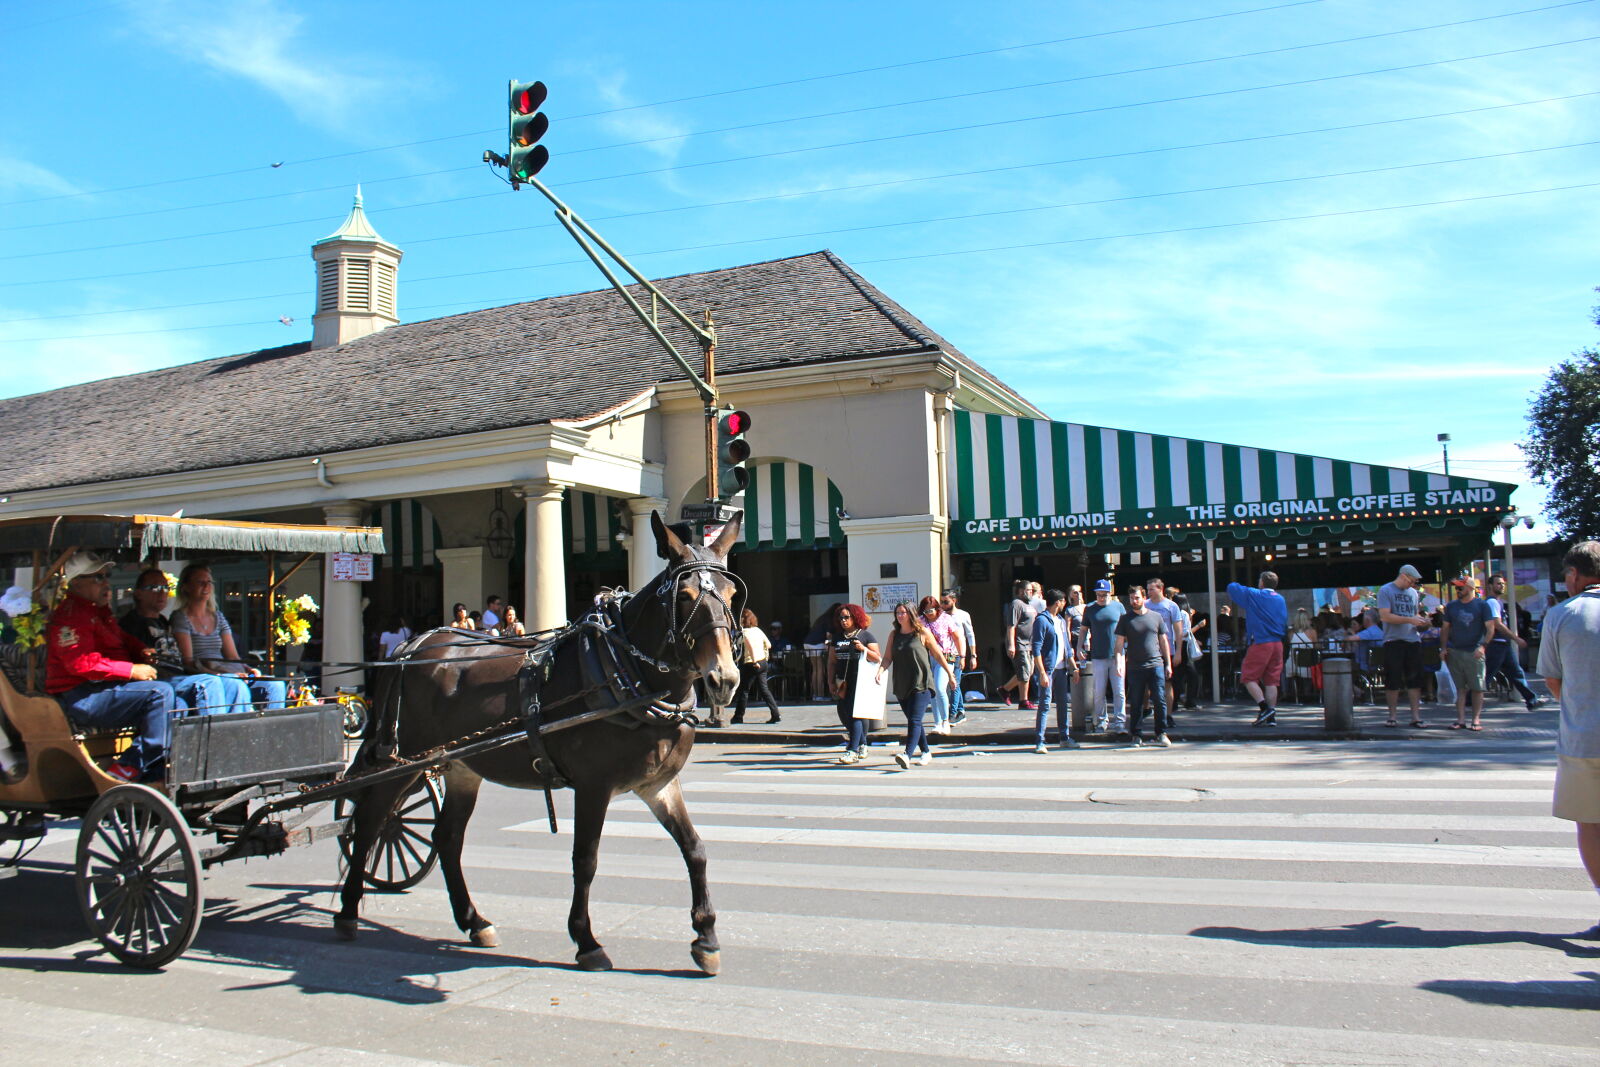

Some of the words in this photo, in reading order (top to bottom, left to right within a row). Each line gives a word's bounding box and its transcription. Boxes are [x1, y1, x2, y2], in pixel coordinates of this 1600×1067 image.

[1186, 504, 1227, 520] THE
[1233, 499, 1330, 517] ORIGINAL
[1337, 493, 1417, 512] COFFEE
[1425, 488, 1496, 506] STAND
[965, 518, 1010, 534] CAFE
[1019, 516, 1044, 531] DU
[1050, 512, 1116, 529] MONDE
